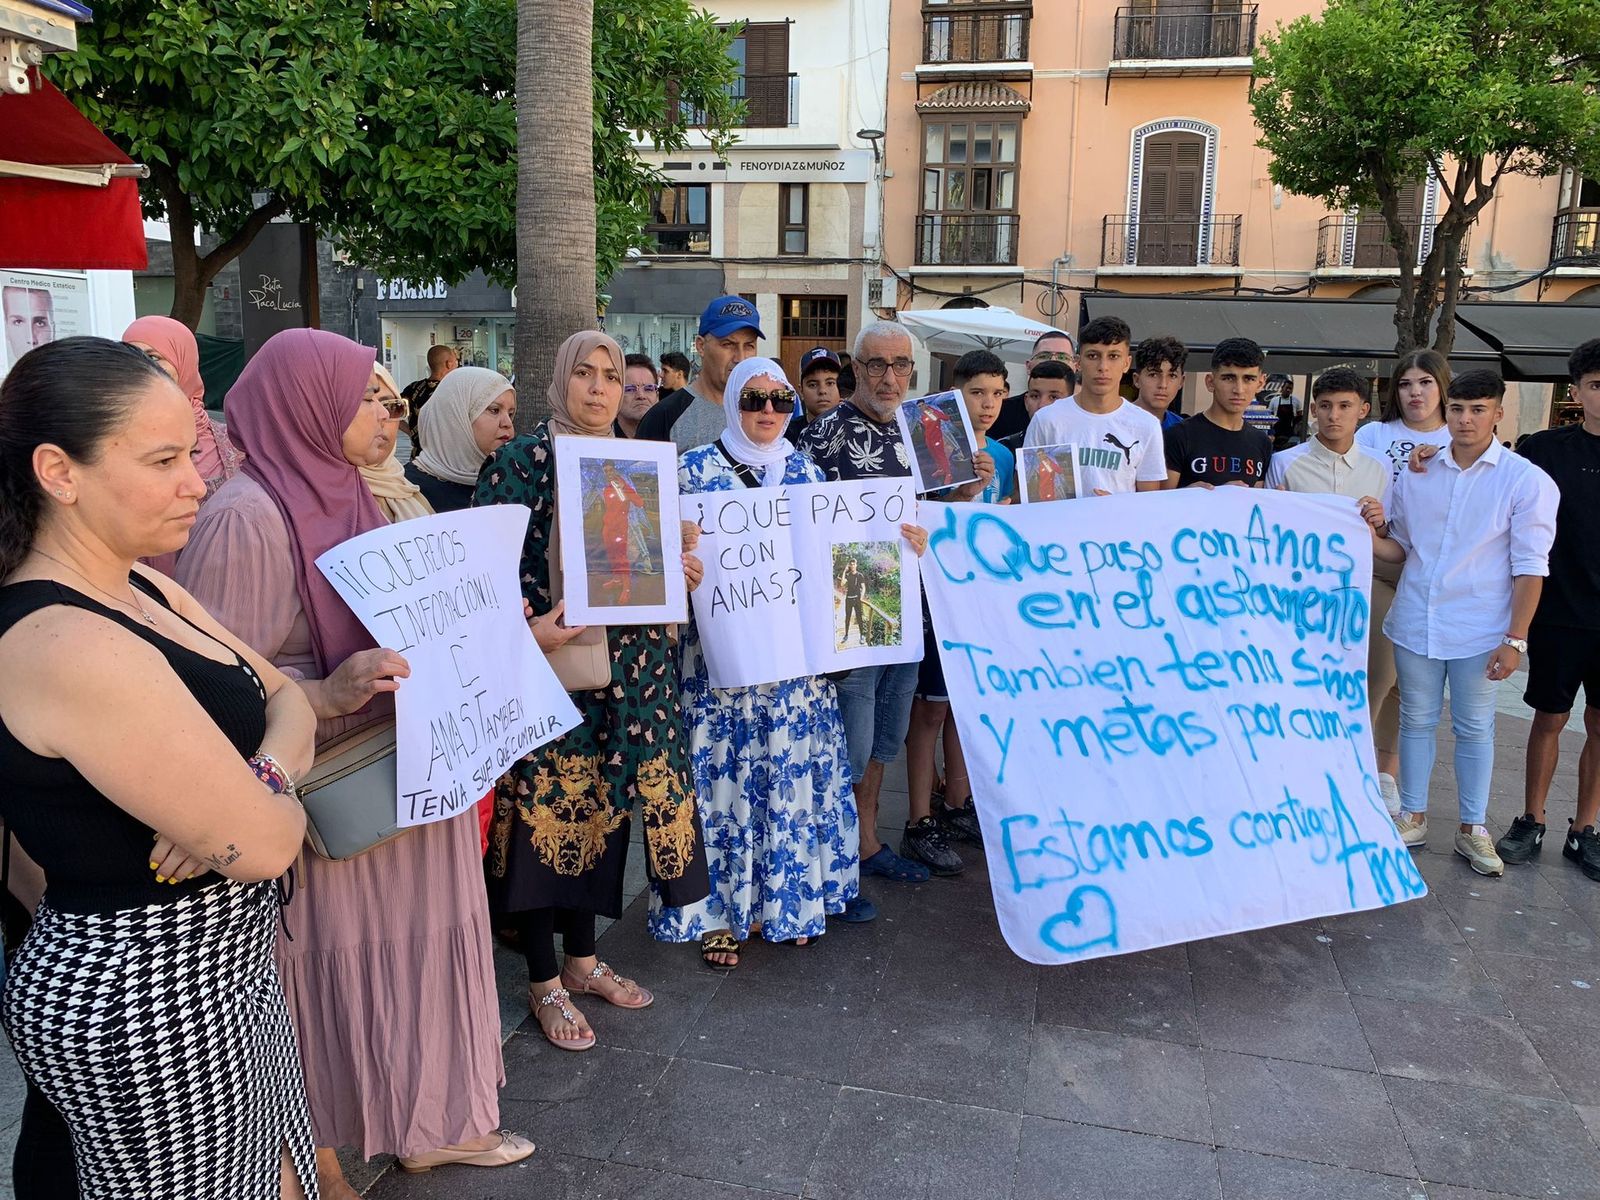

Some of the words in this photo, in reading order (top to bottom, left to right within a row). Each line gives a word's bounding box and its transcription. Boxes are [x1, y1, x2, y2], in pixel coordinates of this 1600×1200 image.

[740, 160, 846, 171] FENOYDIAZ&MUÑOZ
[9, 277, 31, 286] Centro
[259, 274, 283, 293] Ruta
[376, 276, 448, 300] FEMME
[804, 283, 812, 294] 3
[248, 289, 275, 310] Paco
[1079, 447, 1122, 471] UMA
[1191, 456, 1263, 478] GUESS
[697, 489, 793, 536] ¿QUÉ
[811, 484, 906, 525] PASÓ
[719, 539, 776, 571] CON
[929, 506, 1073, 583] ¿Que
[1079, 540, 1163, 604] paso
[1171, 527, 1241, 564] con
[1244, 503, 1355, 574] Anas
[710, 568, 804, 618] ANAS?
[1017, 591, 1102, 629] en
[1112, 569, 1166, 630] el
[942, 639, 1156, 699] Tambien
[1041, 695, 1218, 764] metas
[1226, 701, 1286, 763] por
[1000, 806, 1214, 894] Estamos
[1229, 785, 1338, 865] contigo
